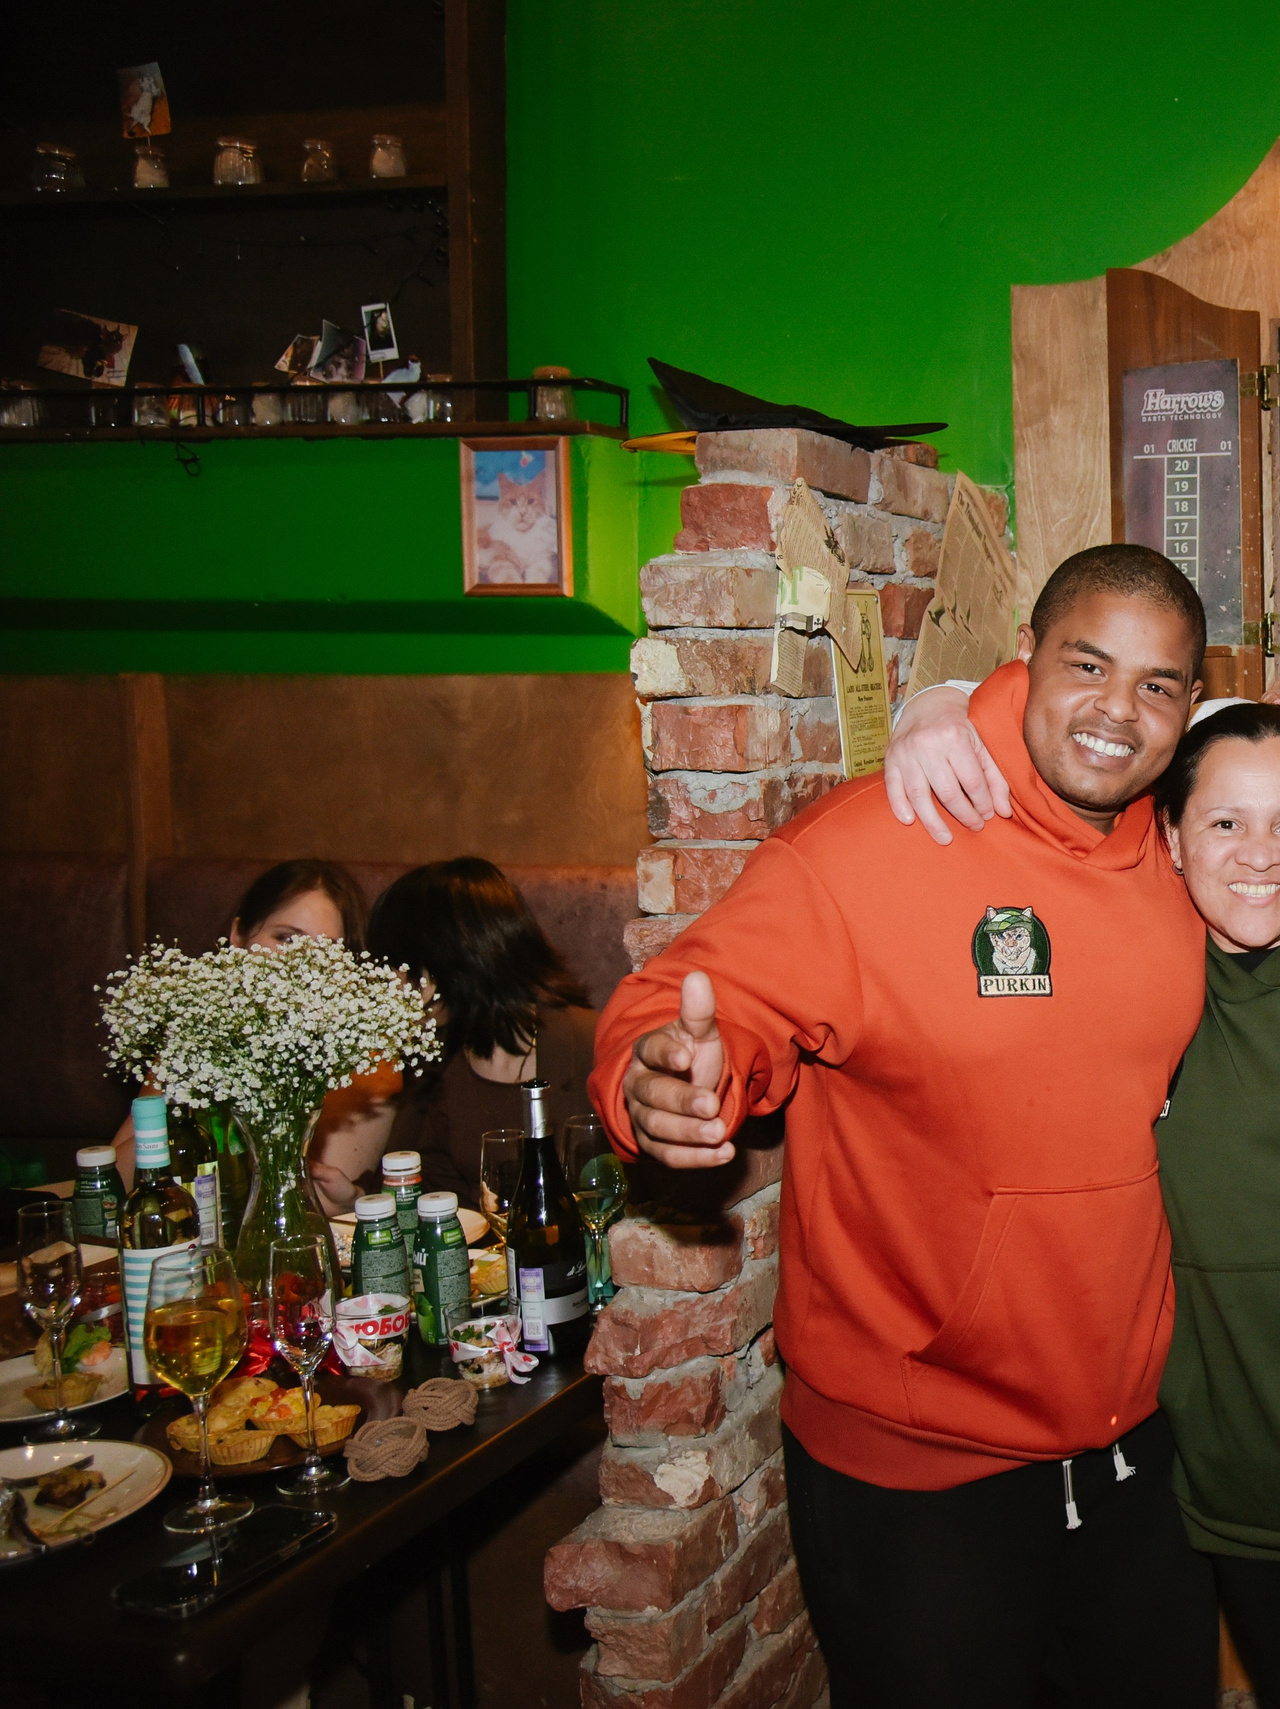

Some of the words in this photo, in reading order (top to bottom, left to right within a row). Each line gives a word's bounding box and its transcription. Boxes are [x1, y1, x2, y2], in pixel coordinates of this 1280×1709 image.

[1141, 389, 1225, 416] Harrows
[1141, 414, 1166, 422] DARTS
[1170, 413, 1222, 421] TECHNOLOGY
[1143, 444, 1155, 454] 01
[1167, 439, 1197, 453] CRICKET
[1220, 440, 1232, 450] 01
[1175, 460, 1189, 472] 20
[1174, 480, 1189, 493] 19
[1174, 501, 1189, 513] 18
[1174, 522, 1189, 534] 17
[1174, 542, 1188, 554] 16
[983, 977, 1047, 993] PURKIN
